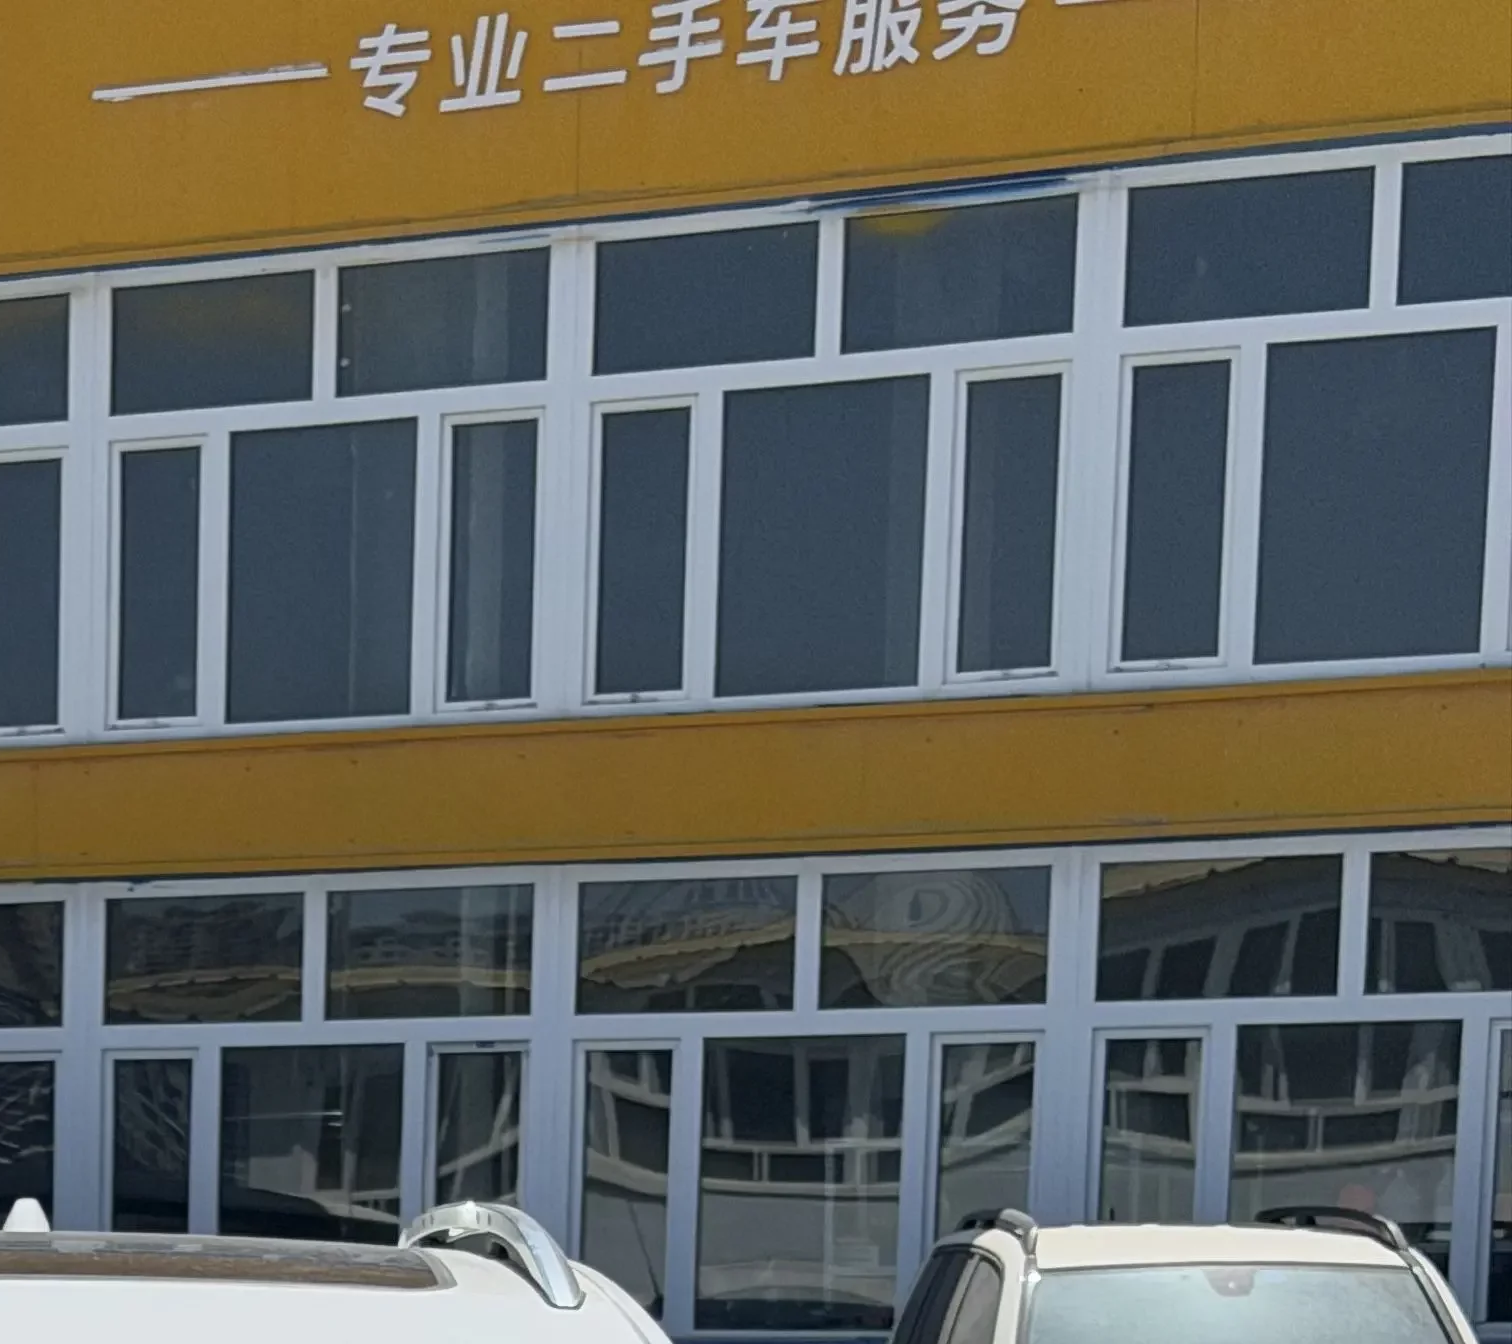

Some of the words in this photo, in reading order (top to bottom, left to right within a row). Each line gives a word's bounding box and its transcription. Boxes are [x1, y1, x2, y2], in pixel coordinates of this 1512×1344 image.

[350, 0, 1025, 117] 专业二手车服务
